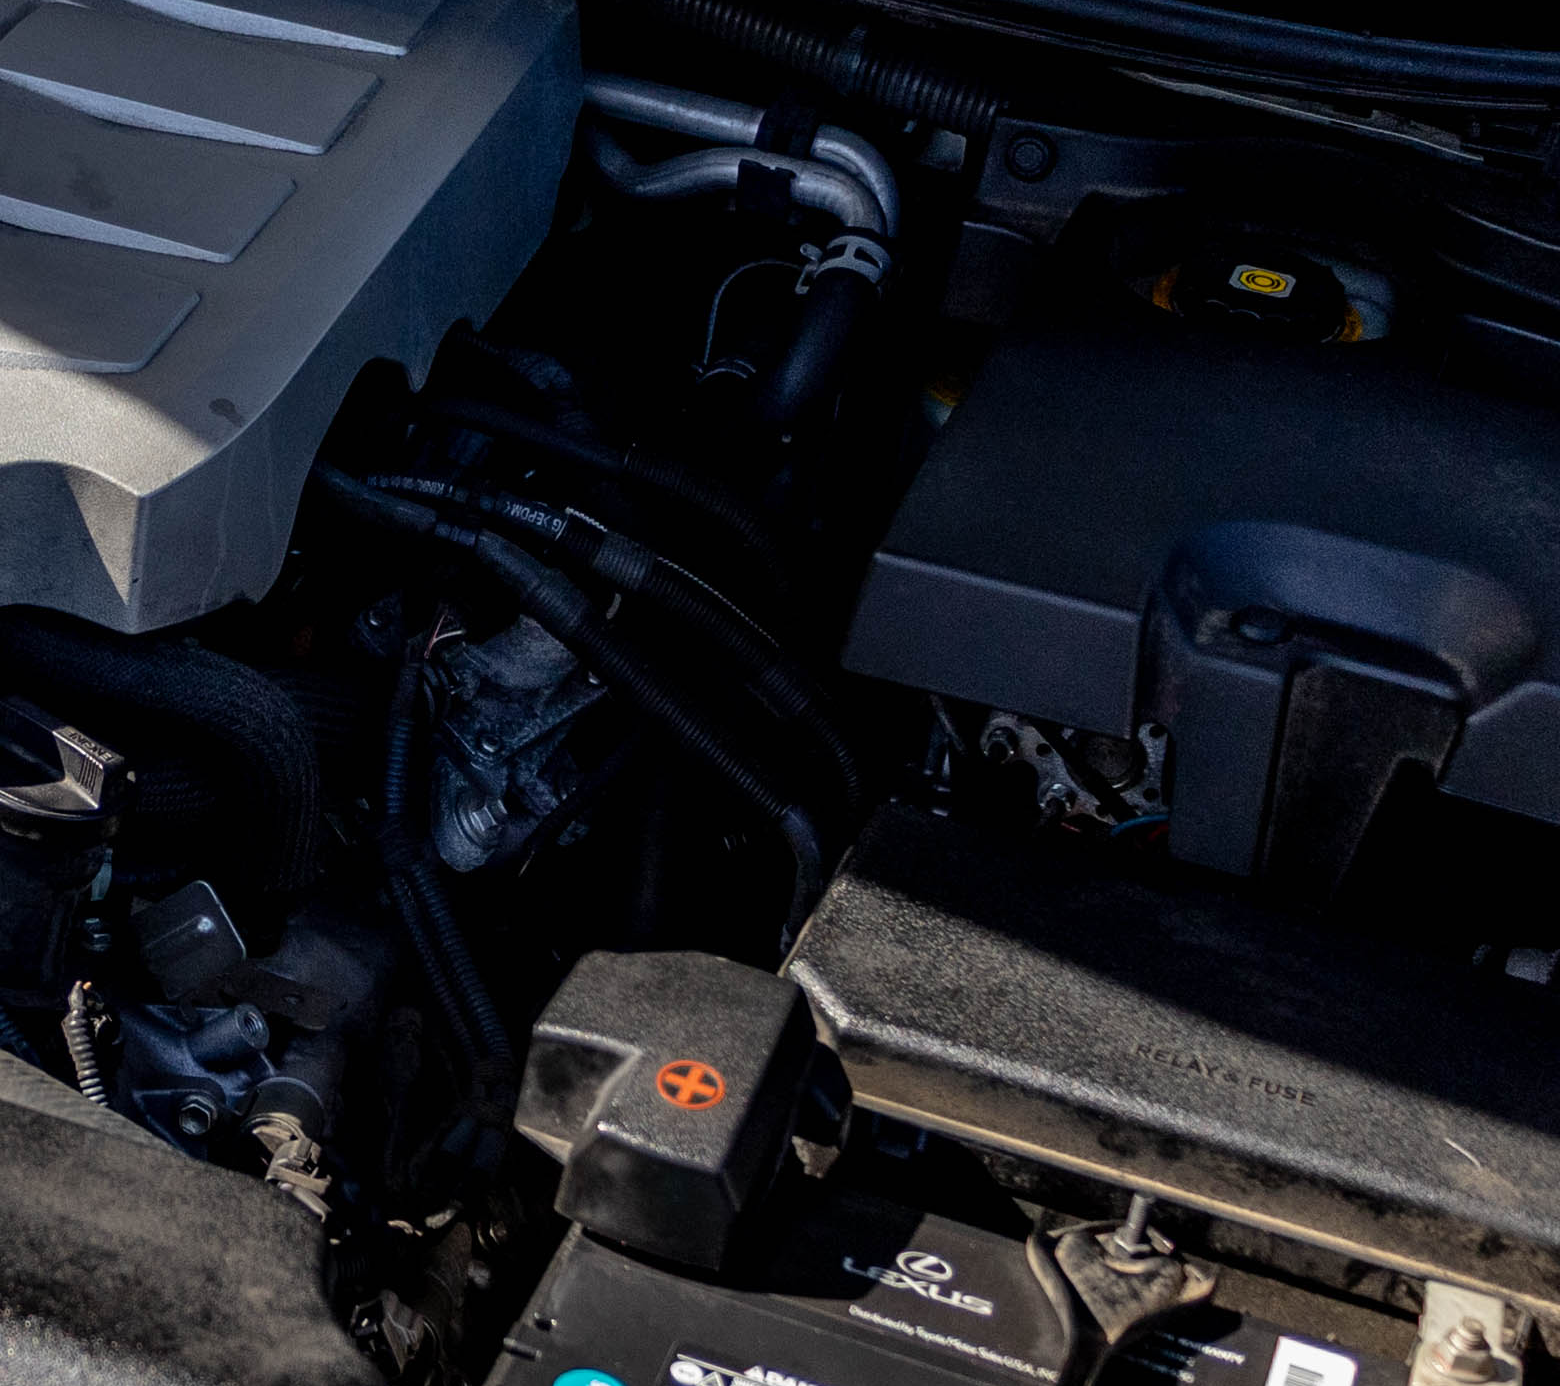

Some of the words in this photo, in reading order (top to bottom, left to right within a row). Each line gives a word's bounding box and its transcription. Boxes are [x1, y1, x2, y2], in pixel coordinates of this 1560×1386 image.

[1135, 1043, 1220, 1078] RELAY
[1223, 1071, 1239, 1084] &
[1248, 1076, 1318, 1108] FUSE
[842, 1255, 995, 1317] LEXUS
